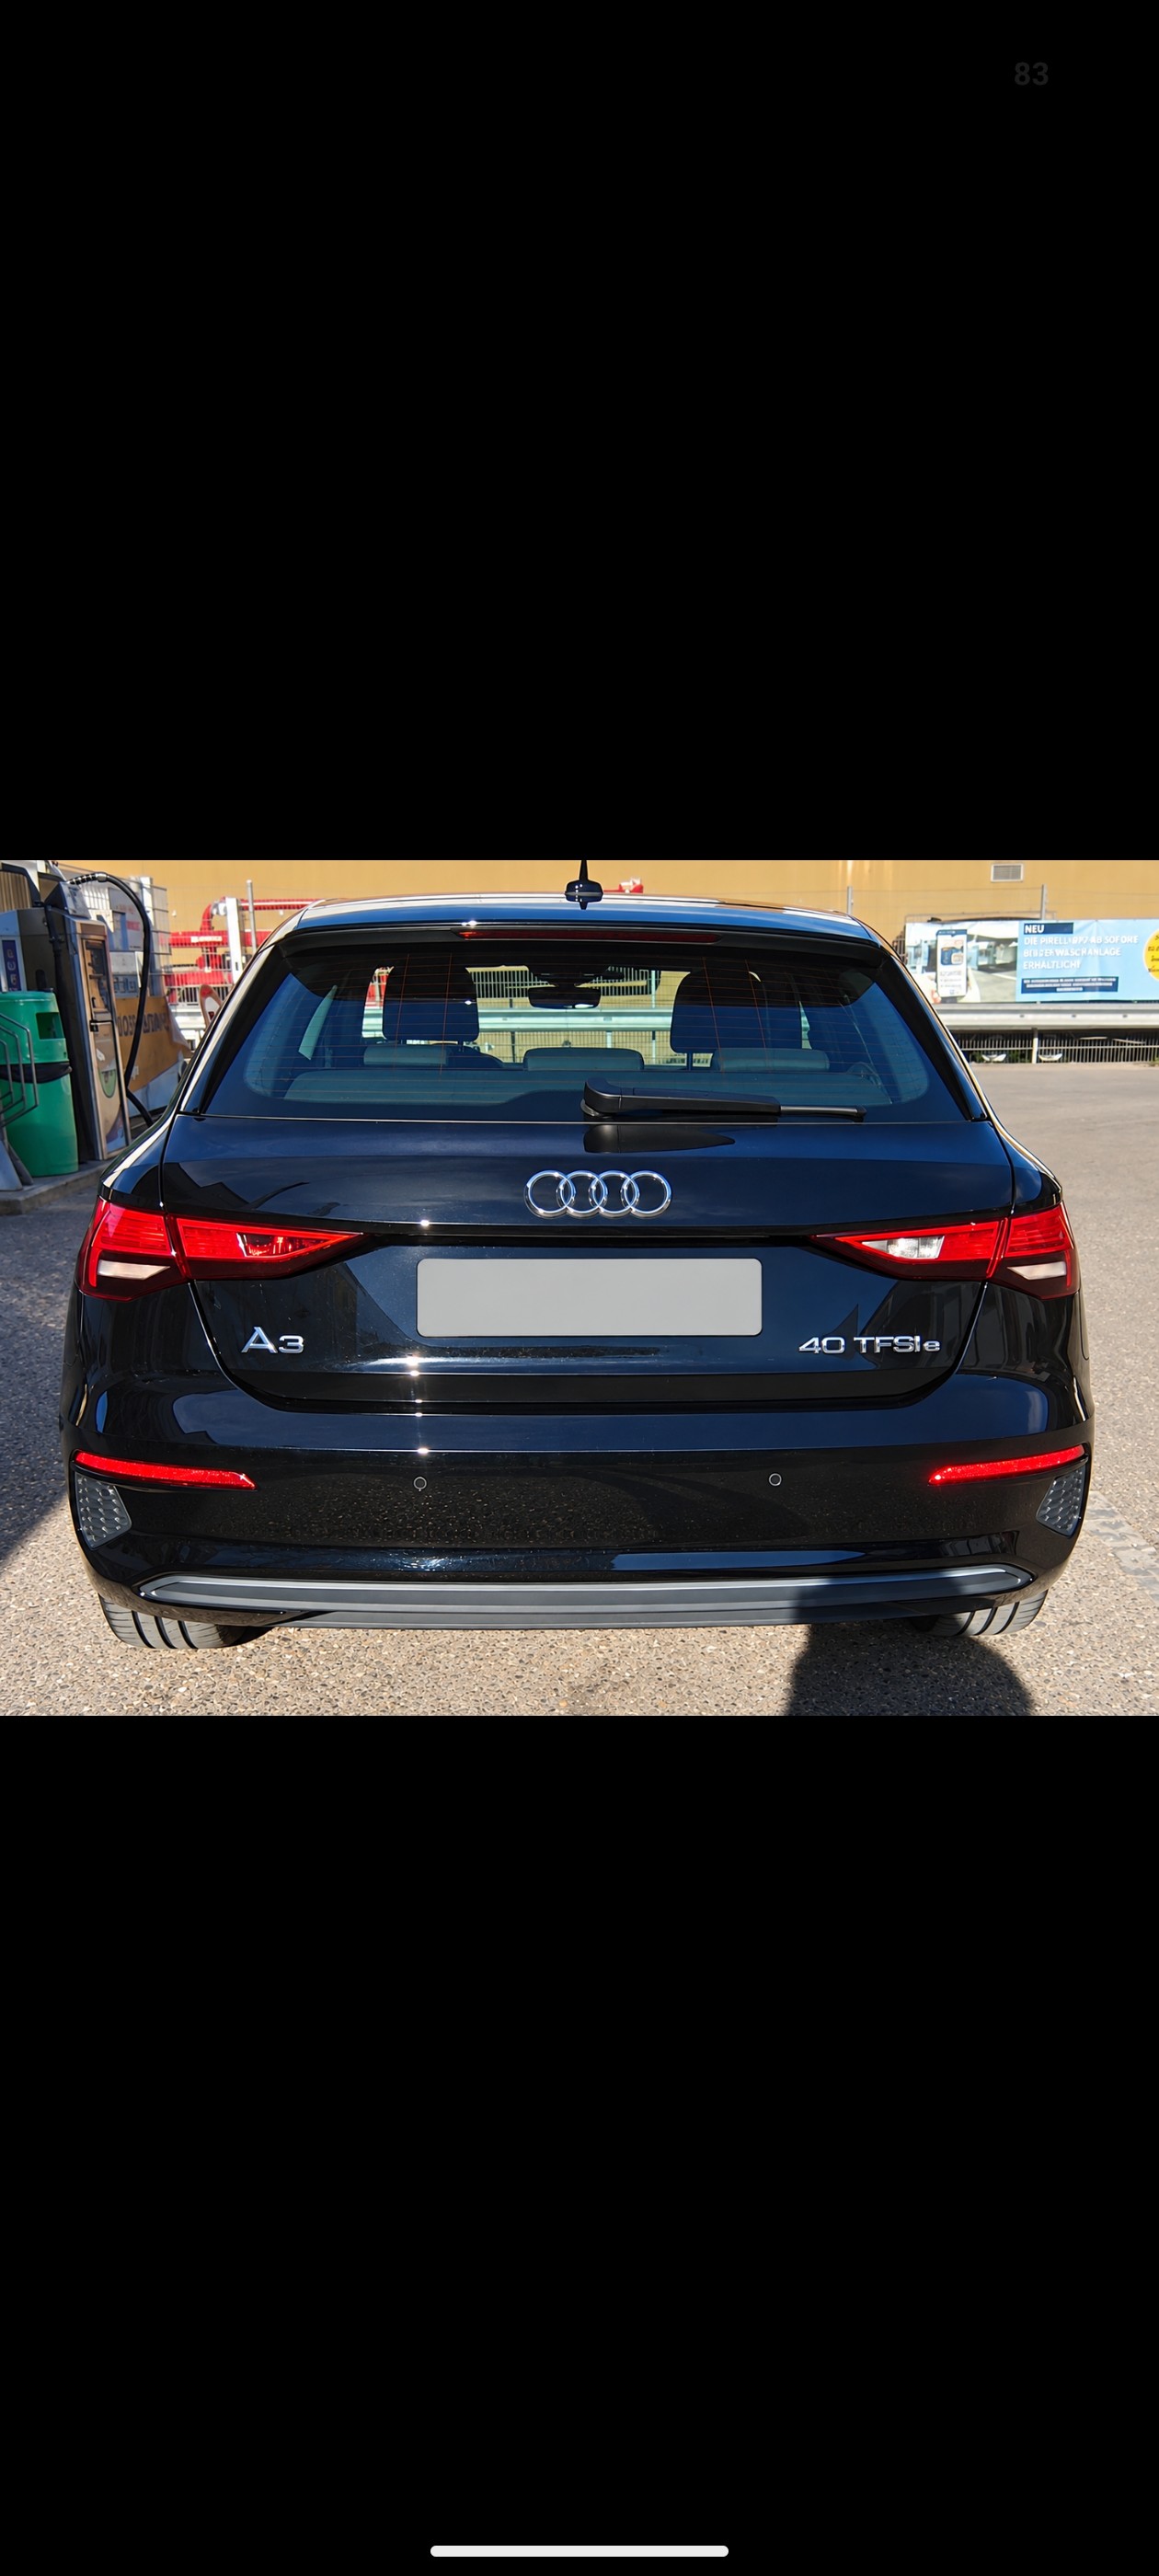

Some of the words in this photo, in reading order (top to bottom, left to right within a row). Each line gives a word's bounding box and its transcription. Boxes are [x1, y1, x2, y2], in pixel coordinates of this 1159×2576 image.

[1025, 925, 1045, 934] NEU
[1024, 937, 1038, 945] DIE
[241, 1326, 304, 1353] A3
[798, 1336, 844, 1354] 40
